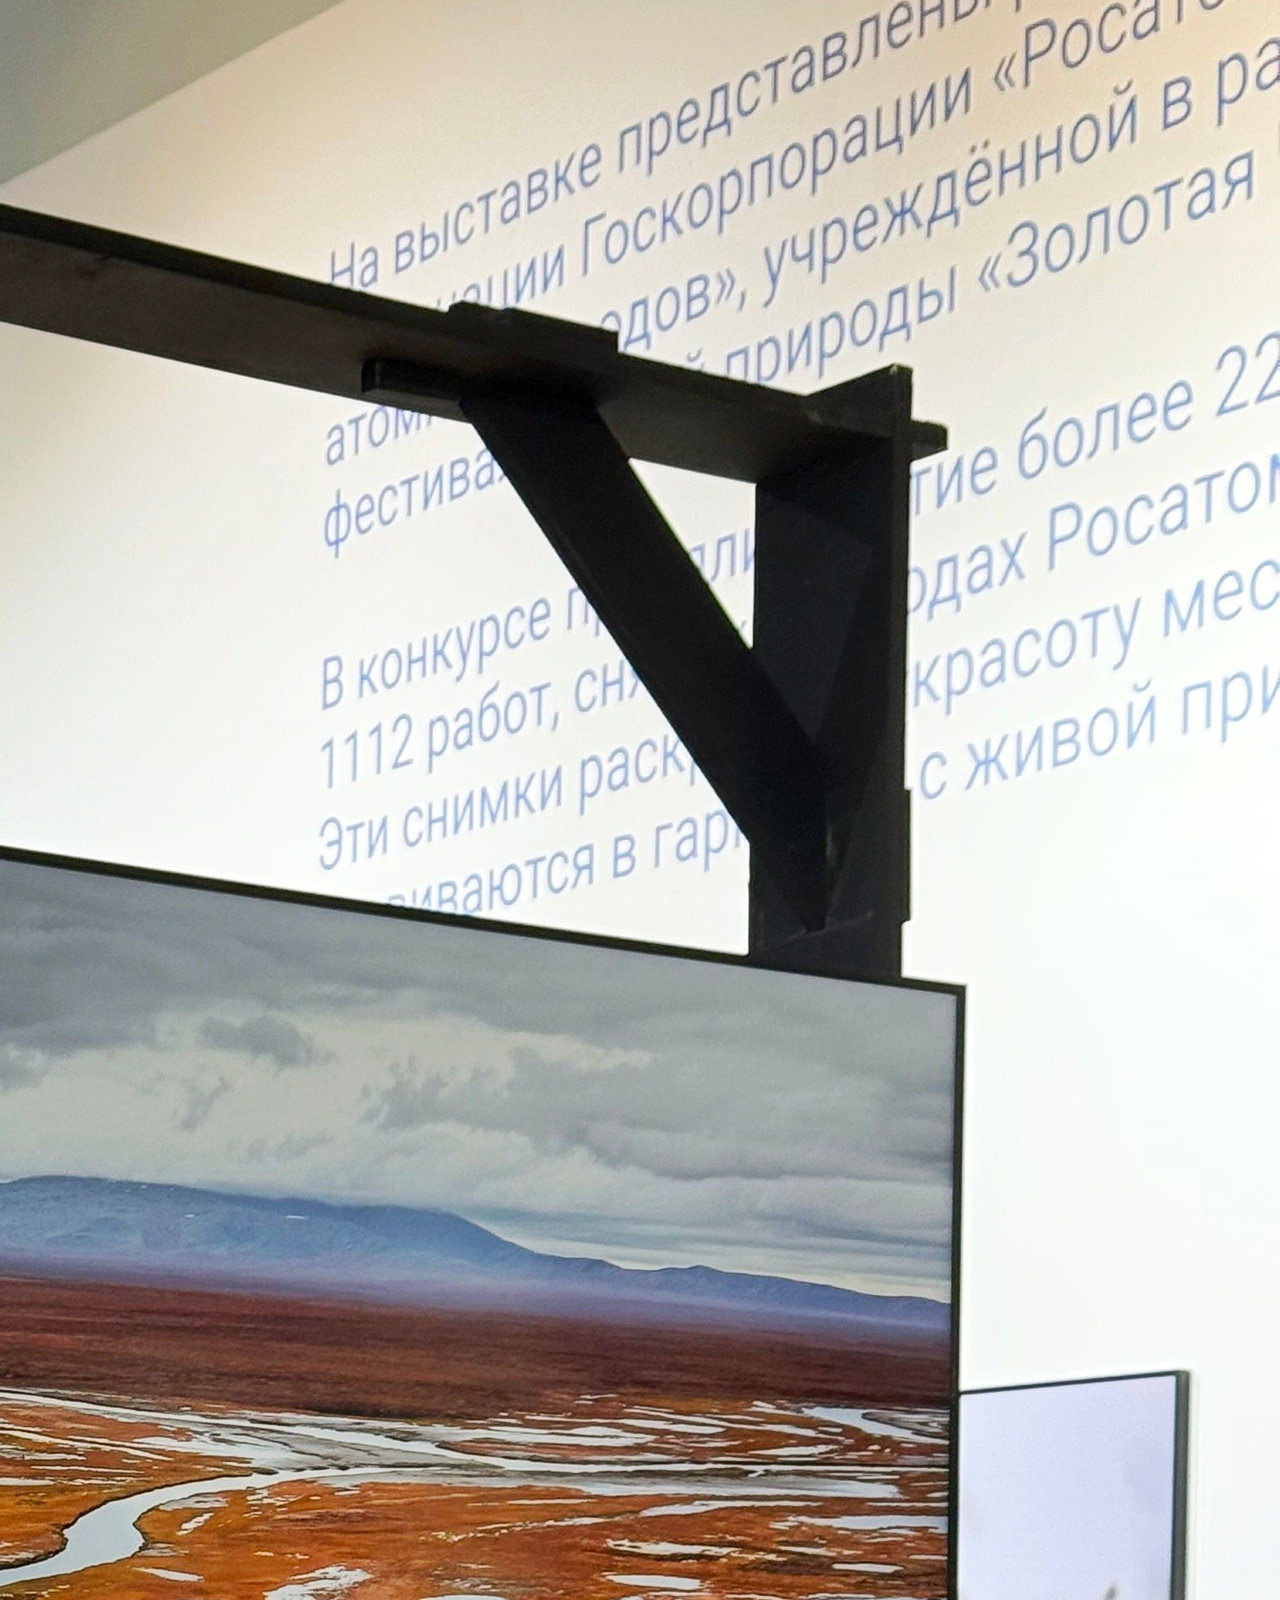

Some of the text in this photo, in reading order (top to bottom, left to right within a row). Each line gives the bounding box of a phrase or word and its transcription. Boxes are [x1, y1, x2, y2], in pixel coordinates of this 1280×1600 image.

[326, 400, 434, 467] атом
[763, 79, 1138, 308] учреждённой
[1161, 75, 1193, 131] в
[330, 241, 379, 289] На
[394, 143, 603, 276] выставке
[581, 65, 972, 277] Госкорпорации
[323, 150, 1255, 560] фестива природы «Золотая
[320, 712, 415, 789] 1112
[428, 680, 560, 774] работ,
[1048, 453, 1280, 572] Росато
[321, 655, 344, 711] В
[357, 596, 551, 700] конкурсе
[1019, 379, 1194, 480] более
[319, 815, 389, 871] Эти
[403, 764, 563, 848] снимки
[913, 596, 1142, 718] красоту
[612, 834, 637, 880] в
[920, 750, 948, 800] с
[965, 677, 1156, 791] живой
